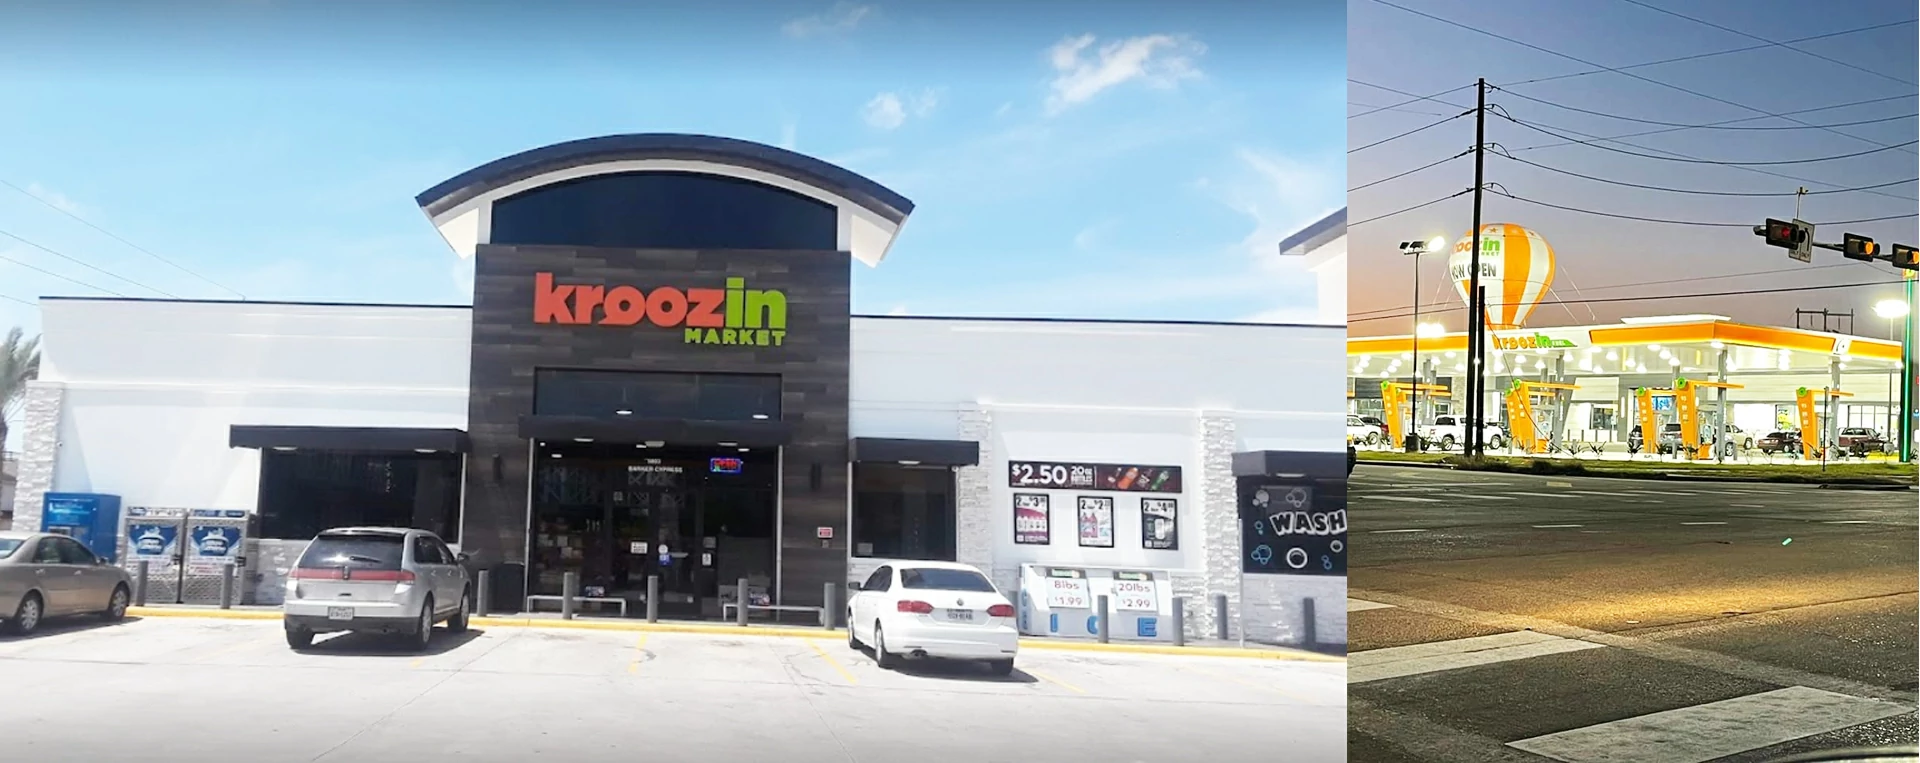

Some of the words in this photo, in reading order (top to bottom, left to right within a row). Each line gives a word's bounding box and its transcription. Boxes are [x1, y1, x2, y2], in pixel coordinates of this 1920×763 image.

[1454, 237, 1500, 252] ooin
[533, 272, 787, 328] kroozin
[684, 327, 787, 346] MARKET
[1012, 463, 1067, 484] $2.50
[1269, 509, 1347, 536] WASH
[1054, 580, 1080, 590] 8lbs
[1119, 582, 1151, 592] 20lbs
[1055, 596, 1082, 606] $1.99
[1122, 598, 1151, 608] $2.99
[1050, 613, 1157, 637] ICE
